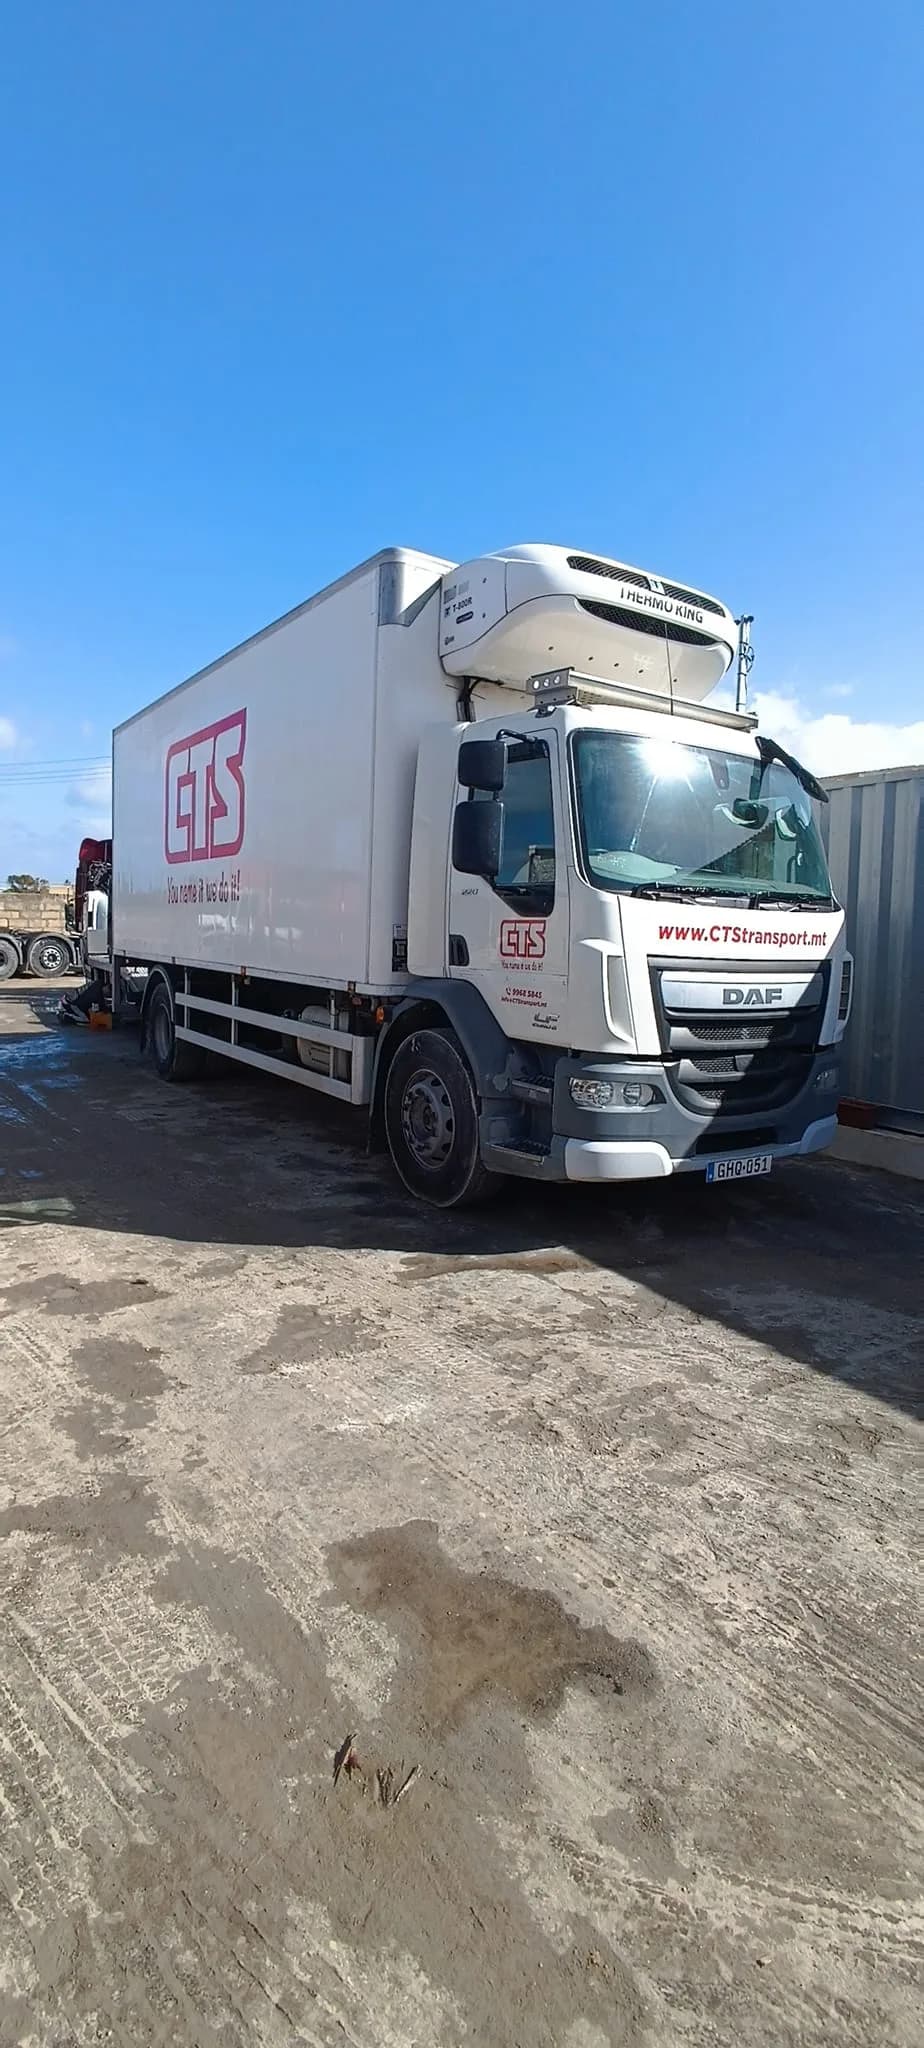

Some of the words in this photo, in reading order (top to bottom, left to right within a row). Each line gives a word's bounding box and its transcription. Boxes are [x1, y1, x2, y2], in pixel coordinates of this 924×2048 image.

[675, 604, 703, 624] KING
[165, 707, 247, 864] CTS
[168, 876, 179, 904] You
[180, 884, 197, 903] name
[198, 878, 204, 902] it
[206, 882, 217, 902] we
[219, 871, 229, 903] do
[231, 869, 240, 902] it!
[500, 920, 546, 958] CTS
[658, 925, 828, 948] www.CTStransport.mt
[722, 988, 782, 1005] DAF
